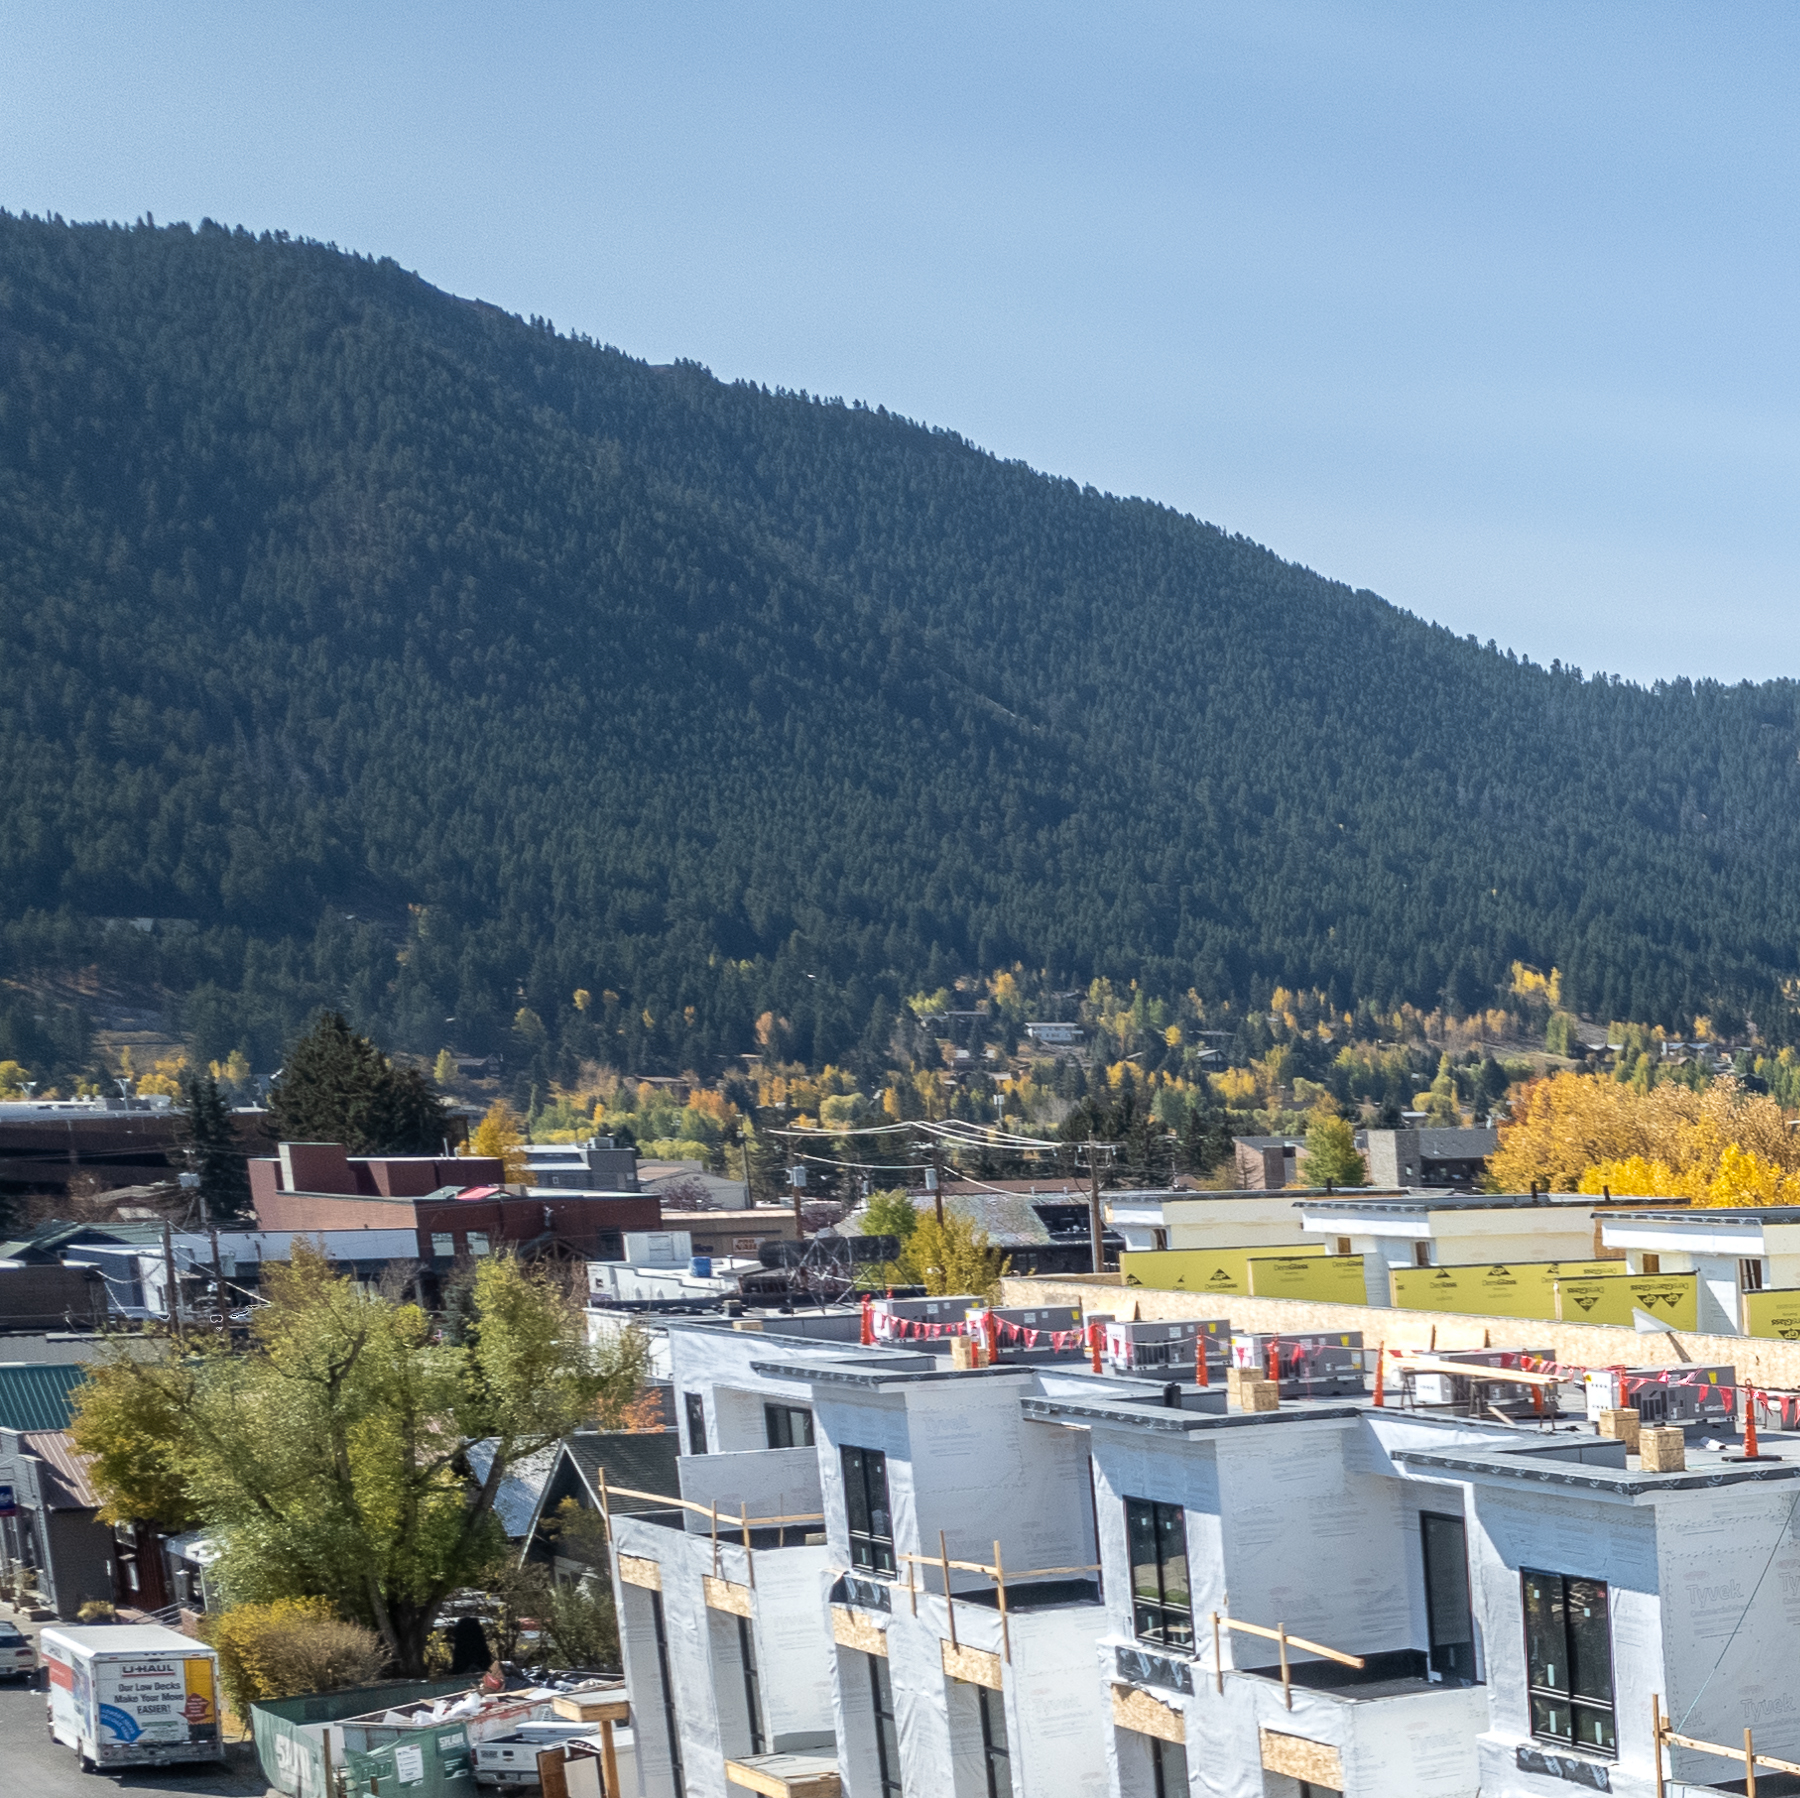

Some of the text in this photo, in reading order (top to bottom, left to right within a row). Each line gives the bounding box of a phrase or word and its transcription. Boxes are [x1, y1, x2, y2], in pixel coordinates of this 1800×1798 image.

[1686, 1579, 1743, 1607] Tyvek
[122, 1664, 175, 1673] U-HAUL
[118, 1682, 181, 1692] Our Low Decks
[114, 1692, 184, 1703] Make Your Move
[137, 1705, 171, 1714] EASIER!
[1740, 1693, 1796, 1721] Tyvek
